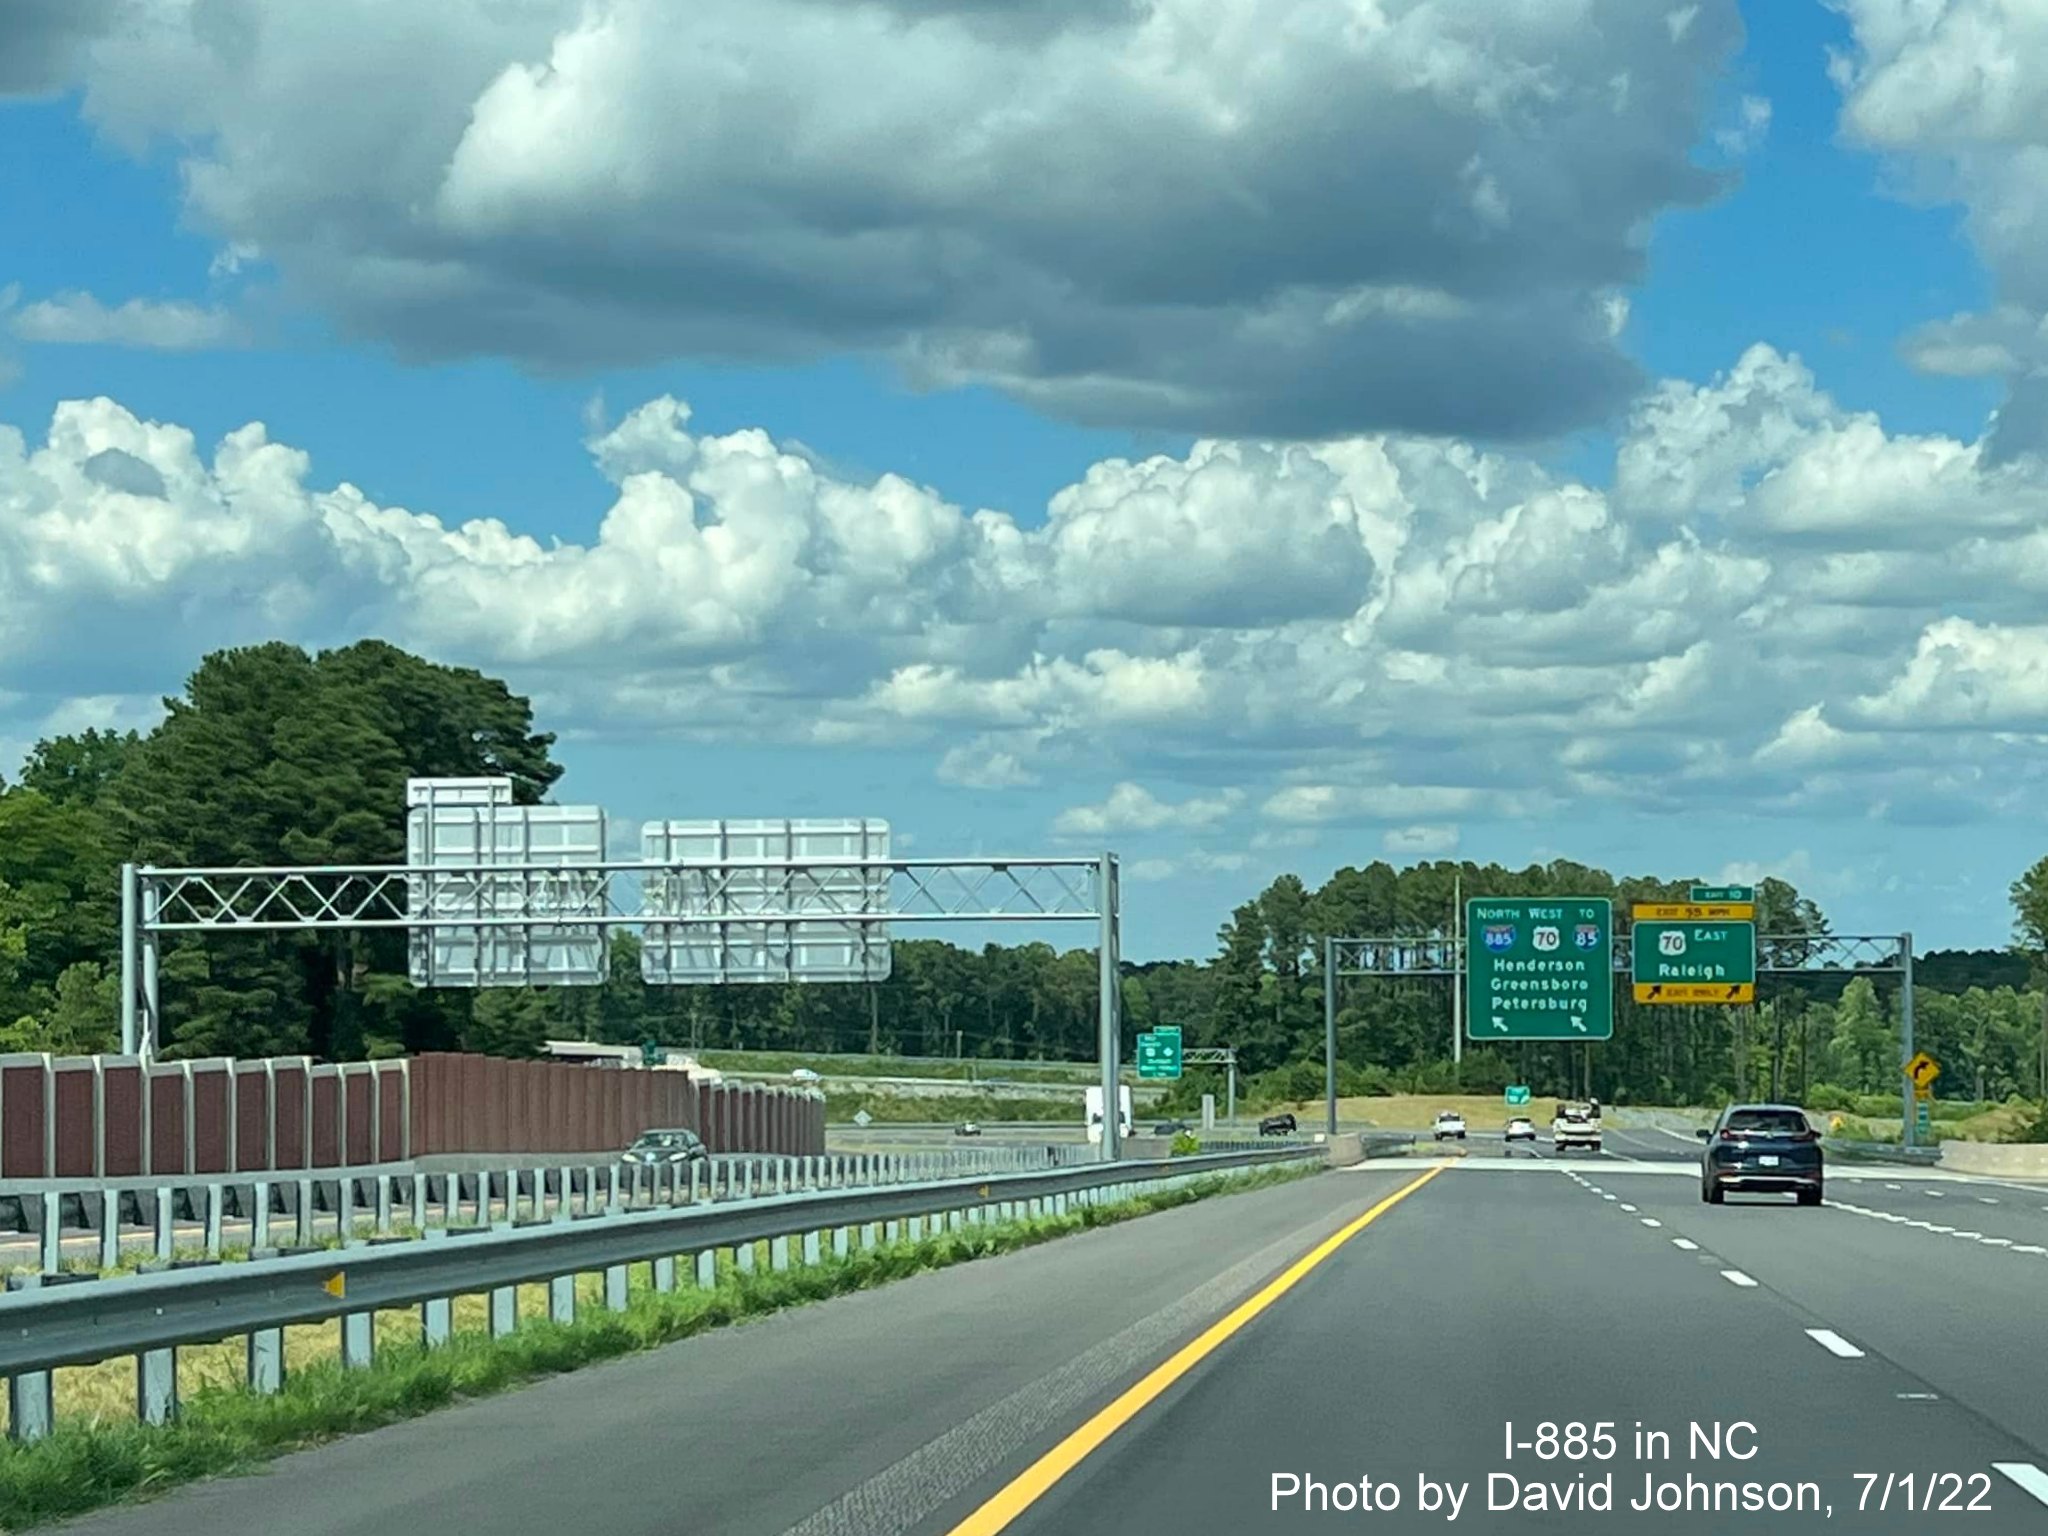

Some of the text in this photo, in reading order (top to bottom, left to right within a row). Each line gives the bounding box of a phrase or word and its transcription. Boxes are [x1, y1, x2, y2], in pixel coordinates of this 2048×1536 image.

[1476, 907, 1595, 919] NORTH WEST TO
[1536, 931, 1557, 946] 70
[1576, 932, 1598, 946] 85
[1662, 928, 1728, 951] 70 EAST
[1493, 958, 1585, 972] Henderson
[1659, 963, 1725, 980] Raleigh
[1490, 978, 1589, 991] Greensboro
[1491, 996, 1588, 1013] Petersburg
